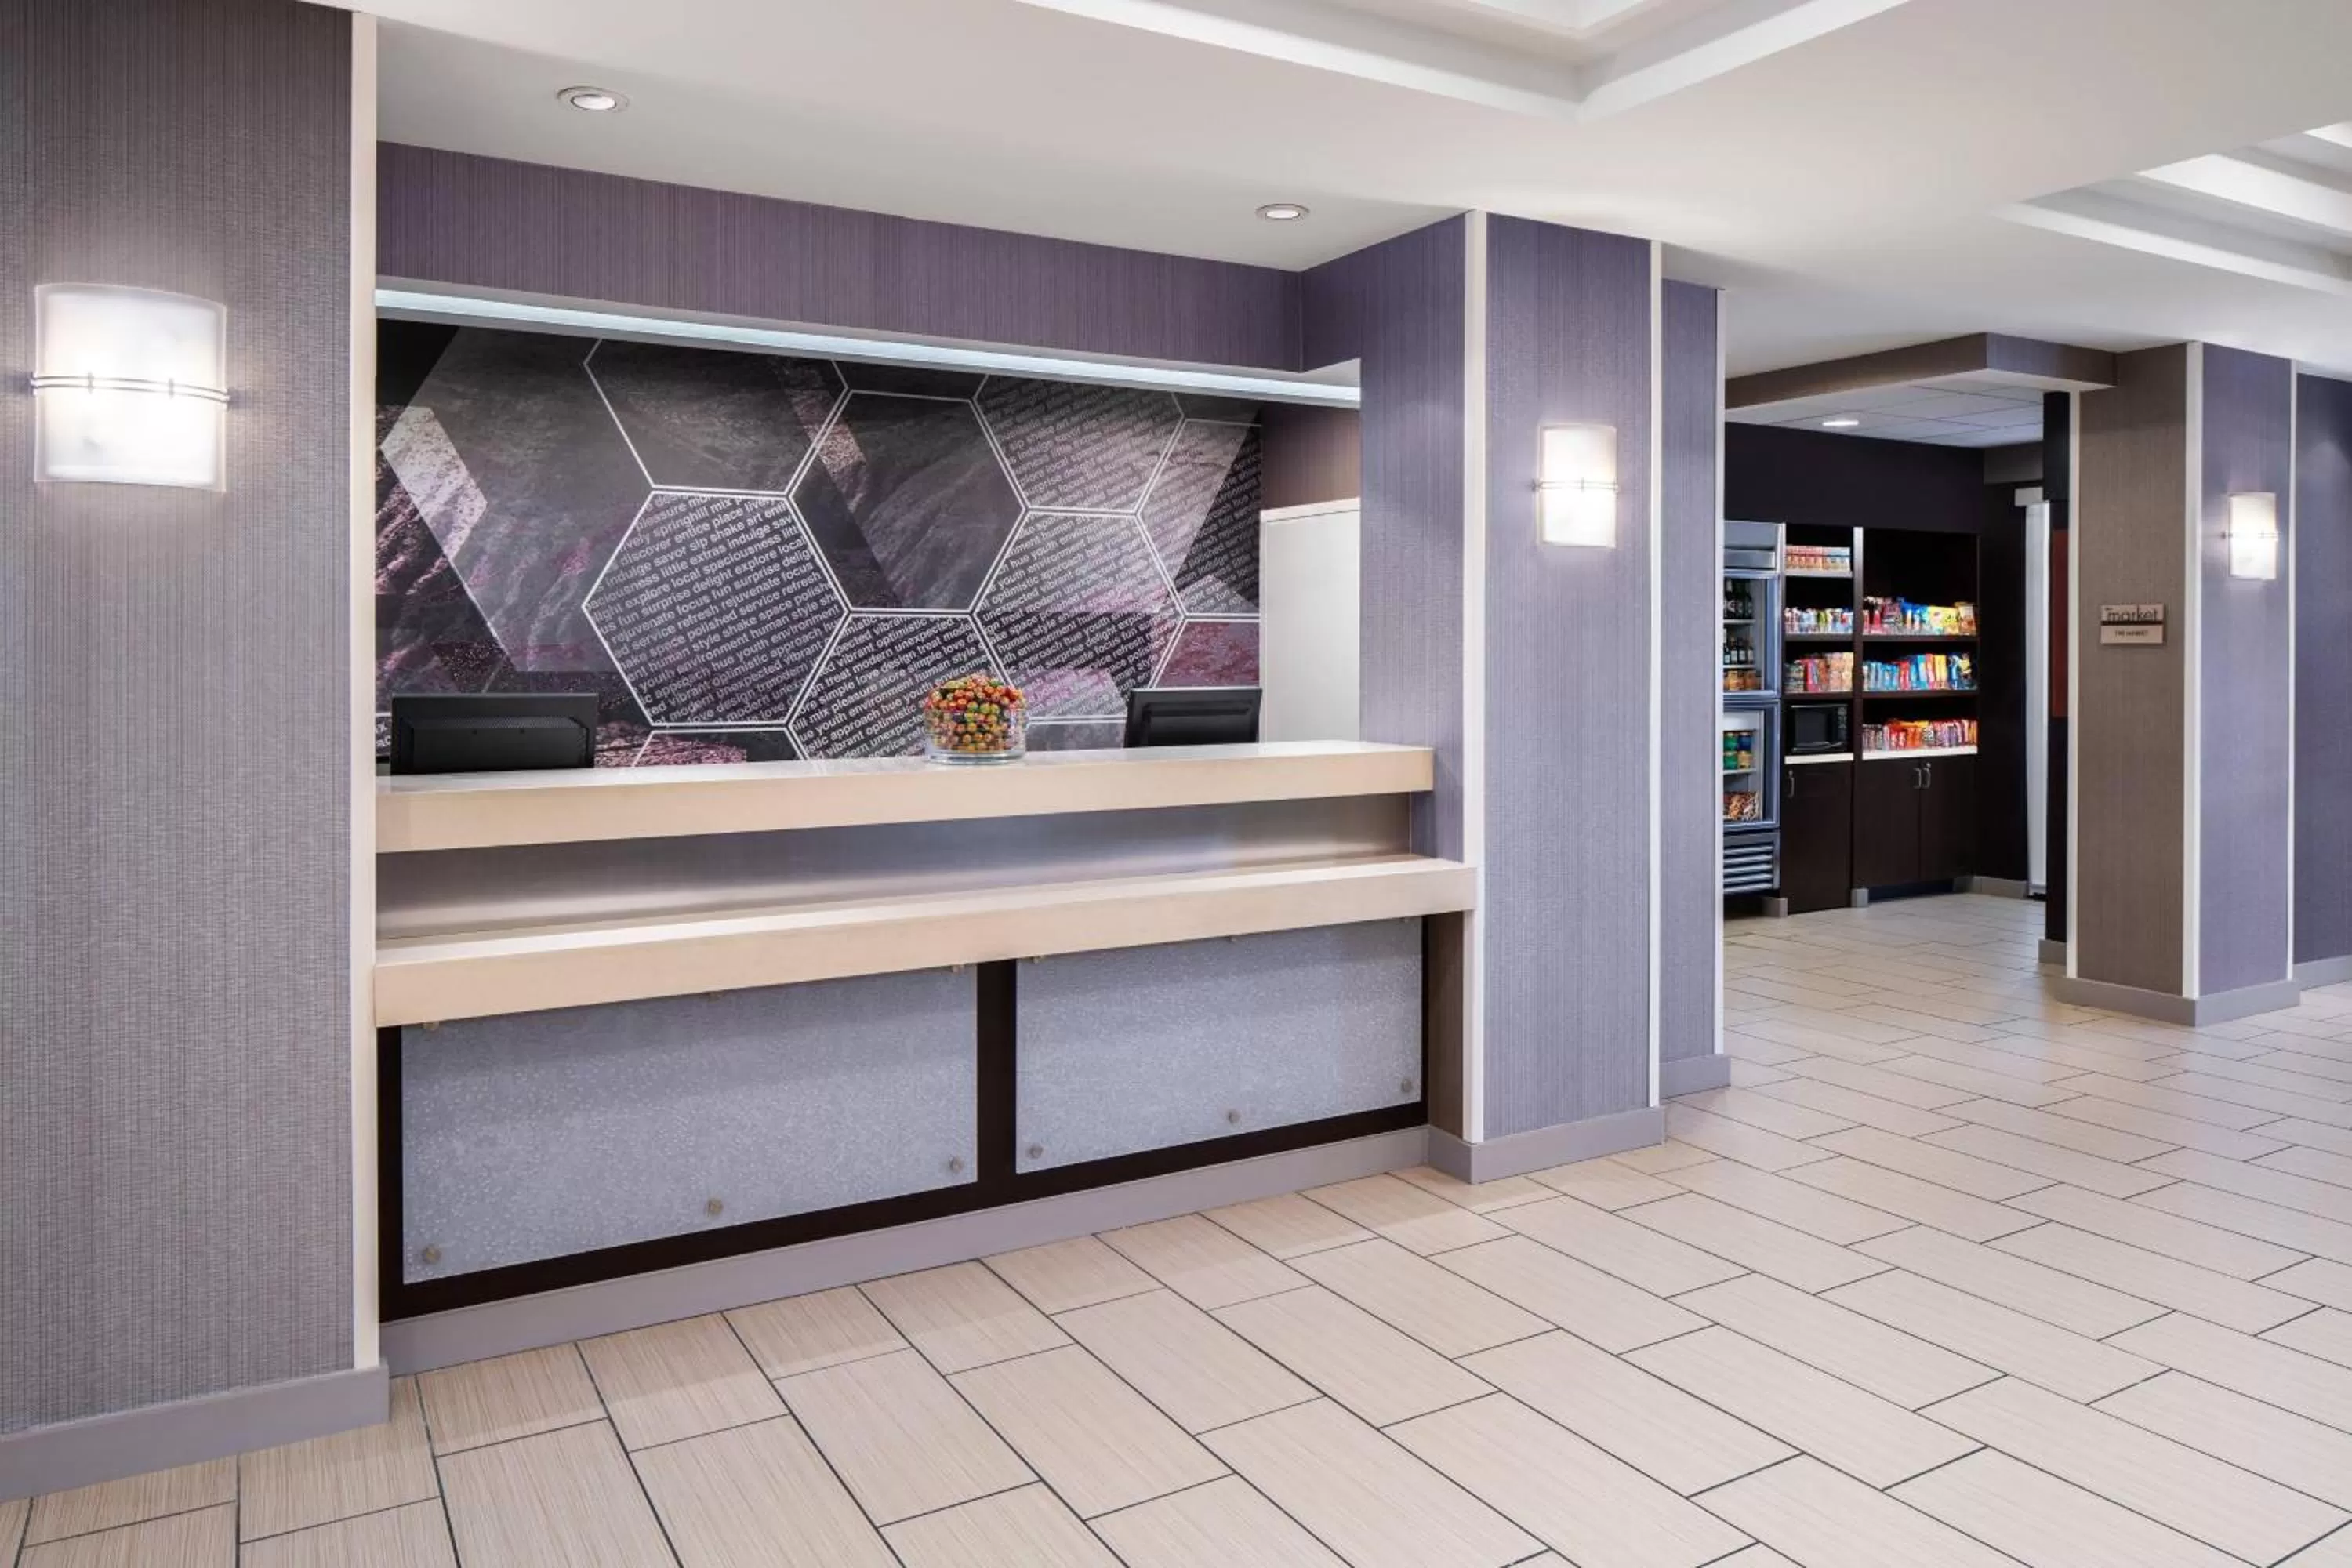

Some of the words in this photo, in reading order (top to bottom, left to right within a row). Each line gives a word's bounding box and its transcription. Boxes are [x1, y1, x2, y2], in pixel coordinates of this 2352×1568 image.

[619, 539, 670, 566] discover
[674, 521, 710, 543] entice
[712, 506, 743, 529] place
[653, 506, 708, 537] springhill
[710, 498, 731, 513] mix
[605, 561, 652, 587] indulge
[654, 546, 687, 567] savor
[688, 537, 710, 551] sip
[710, 521, 744, 542] shake
[746, 512, 761, 526] art
[625, 583, 670, 608] explore
[671, 567, 700, 587] local
[702, 533, 780, 574] spaciousness
[660, 560, 688, 578] little
[689, 543, 726, 565] extras
[727, 524, 771, 548] indulge
[992, 575, 1039, 604] optimistic
[1040, 551, 1084, 579] approach
[997, 568, 1025, 590] youth
[1027, 538, 1085, 573] environment
[1009, 554, 1029, 568] hue
[1031, 538, 1058, 560] youth
[612, 610, 675, 644] rejuvenate
[676, 594, 710, 615] focus
[711, 584, 731, 599] fun
[734, 562, 780, 589] surprise
[618, 611, 639, 626] fun
[641, 588, 690, 616] surprise
[691, 568, 732, 593] delight
[735, 550, 777, 574] explore
[632, 624, 676, 650] service
[677, 603, 718, 629] refresh
[721, 576, 780, 608] rejuvenate
[780, 561, 812, 581] focus
[649, 634, 684, 656] space
[687, 608, 737, 641] polished
[739, 590, 780, 615] service
[781, 570, 821, 595] refresh
[982, 587, 1038, 622] unexpected
[1040, 570, 1073, 593] vibrant
[1000, 608, 1023, 625] treat
[1025, 590, 1062, 613] modern
[1063, 560, 1118, 593] unexpected
[1009, 615, 1037, 633] space
[1039, 591, 1080, 621] polished
[639, 666, 674, 693] youth
[676, 632, 748, 673] environment
[750, 615, 789, 639] human
[791, 601, 818, 619] style
[648, 647, 690, 671] human
[691, 633, 720, 652] style
[722, 615, 757, 637] shake
[758, 599, 792, 620] space
[711, 655, 735, 670] hue
[737, 637, 768, 662] youth
[770, 603, 839, 643] environment
[825, 667, 851, 686] treat
[852, 648, 892, 673] modern
[895, 615, 954, 652] unexpected
[837, 642, 873, 667] vibrant
[876, 617, 927, 648] optimistic
[997, 631, 1031, 652] human
[1033, 619, 1055, 635] style
[1058, 603, 1086, 622] shake
[1017, 619, 1076, 655] environment
[1018, 640, 1062, 669] approach
[1063, 630, 1082, 644] hue
[1083, 615, 1109, 637] youth
[1046, 642, 1083, 667] surprise
[1083, 623, 1116, 646] delight
[1094, 636, 1120, 654] focus
[1120, 627, 1137, 640] fun
[1112, 633, 1145, 658] refresh
[669, 678, 711, 706] vibrant
[711, 653, 768, 685] optimistic
[769, 626, 822, 658] approach
[669, 693, 713, 720] modern
[716, 659, 782, 698] unexpected
[784, 639, 823, 665] vibrant
[808, 707, 829, 723] mix
[831, 683, 877, 713] pleasure
[879, 669, 906, 688] more
[907, 651, 942, 673] simple
[942, 639, 965, 655] love
[815, 710, 846, 735] youth
[848, 677, 913, 716] environment
[913, 659, 949, 682] human
[951, 646, 976, 663] style
[818, 681, 855, 703] simple
[855, 668, 880, 684] love
[879, 649, 916, 672] design
[916, 635, 940, 653] treat
[715, 688, 753, 711] design
[826, 729, 863, 755] vibrant
[865, 703, 916, 735] optimistic
[829, 707, 880, 739] approach
[880, 698, 902, 713] hue
[903, 680, 932, 704] youth
